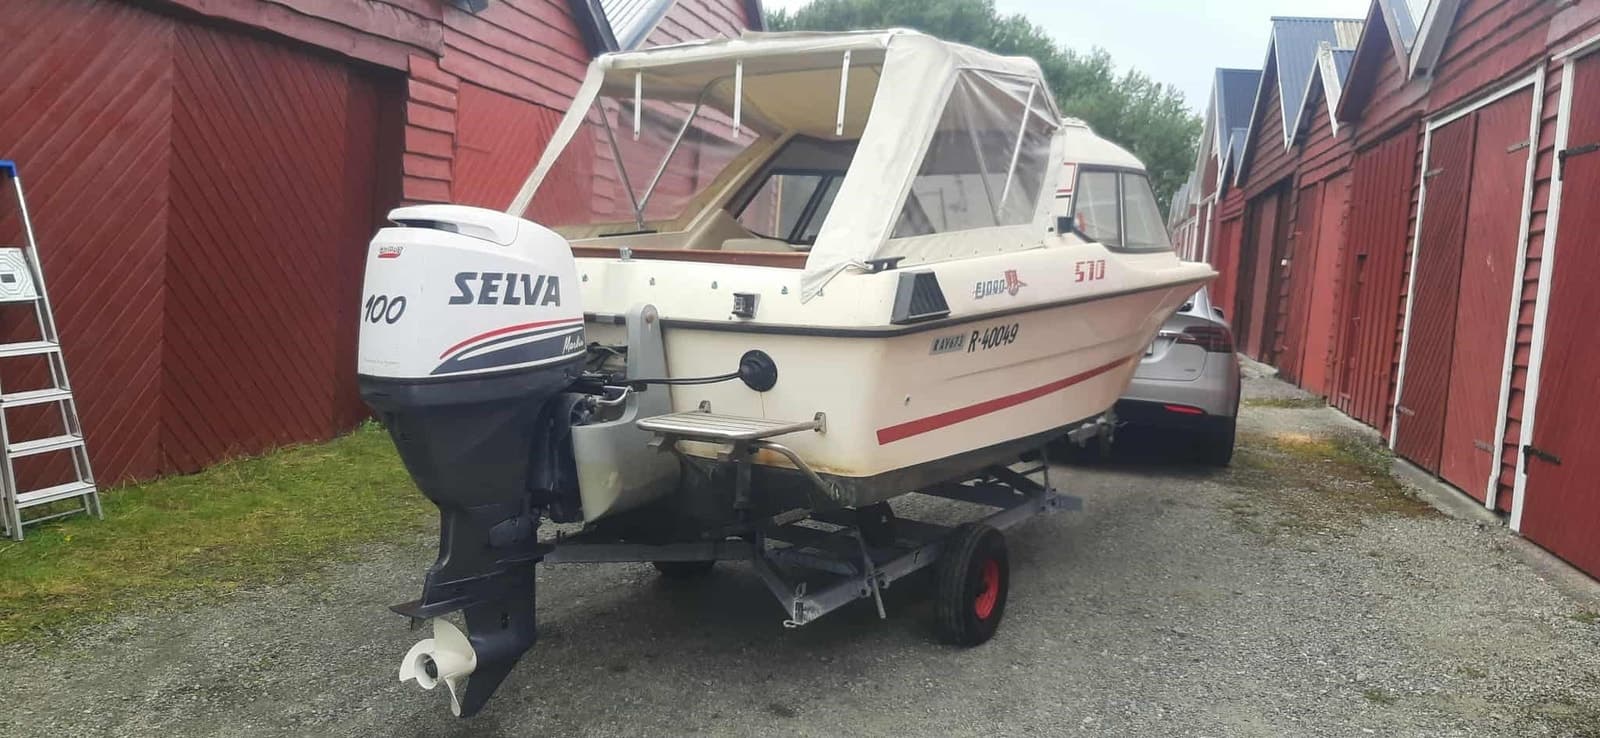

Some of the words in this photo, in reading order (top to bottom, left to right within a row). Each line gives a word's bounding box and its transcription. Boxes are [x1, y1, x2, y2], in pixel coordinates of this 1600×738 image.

[449, 272, 561, 307] SELVA
[365, 294, 407, 324] 100
[967, 323, 1019, 353] R-40049
